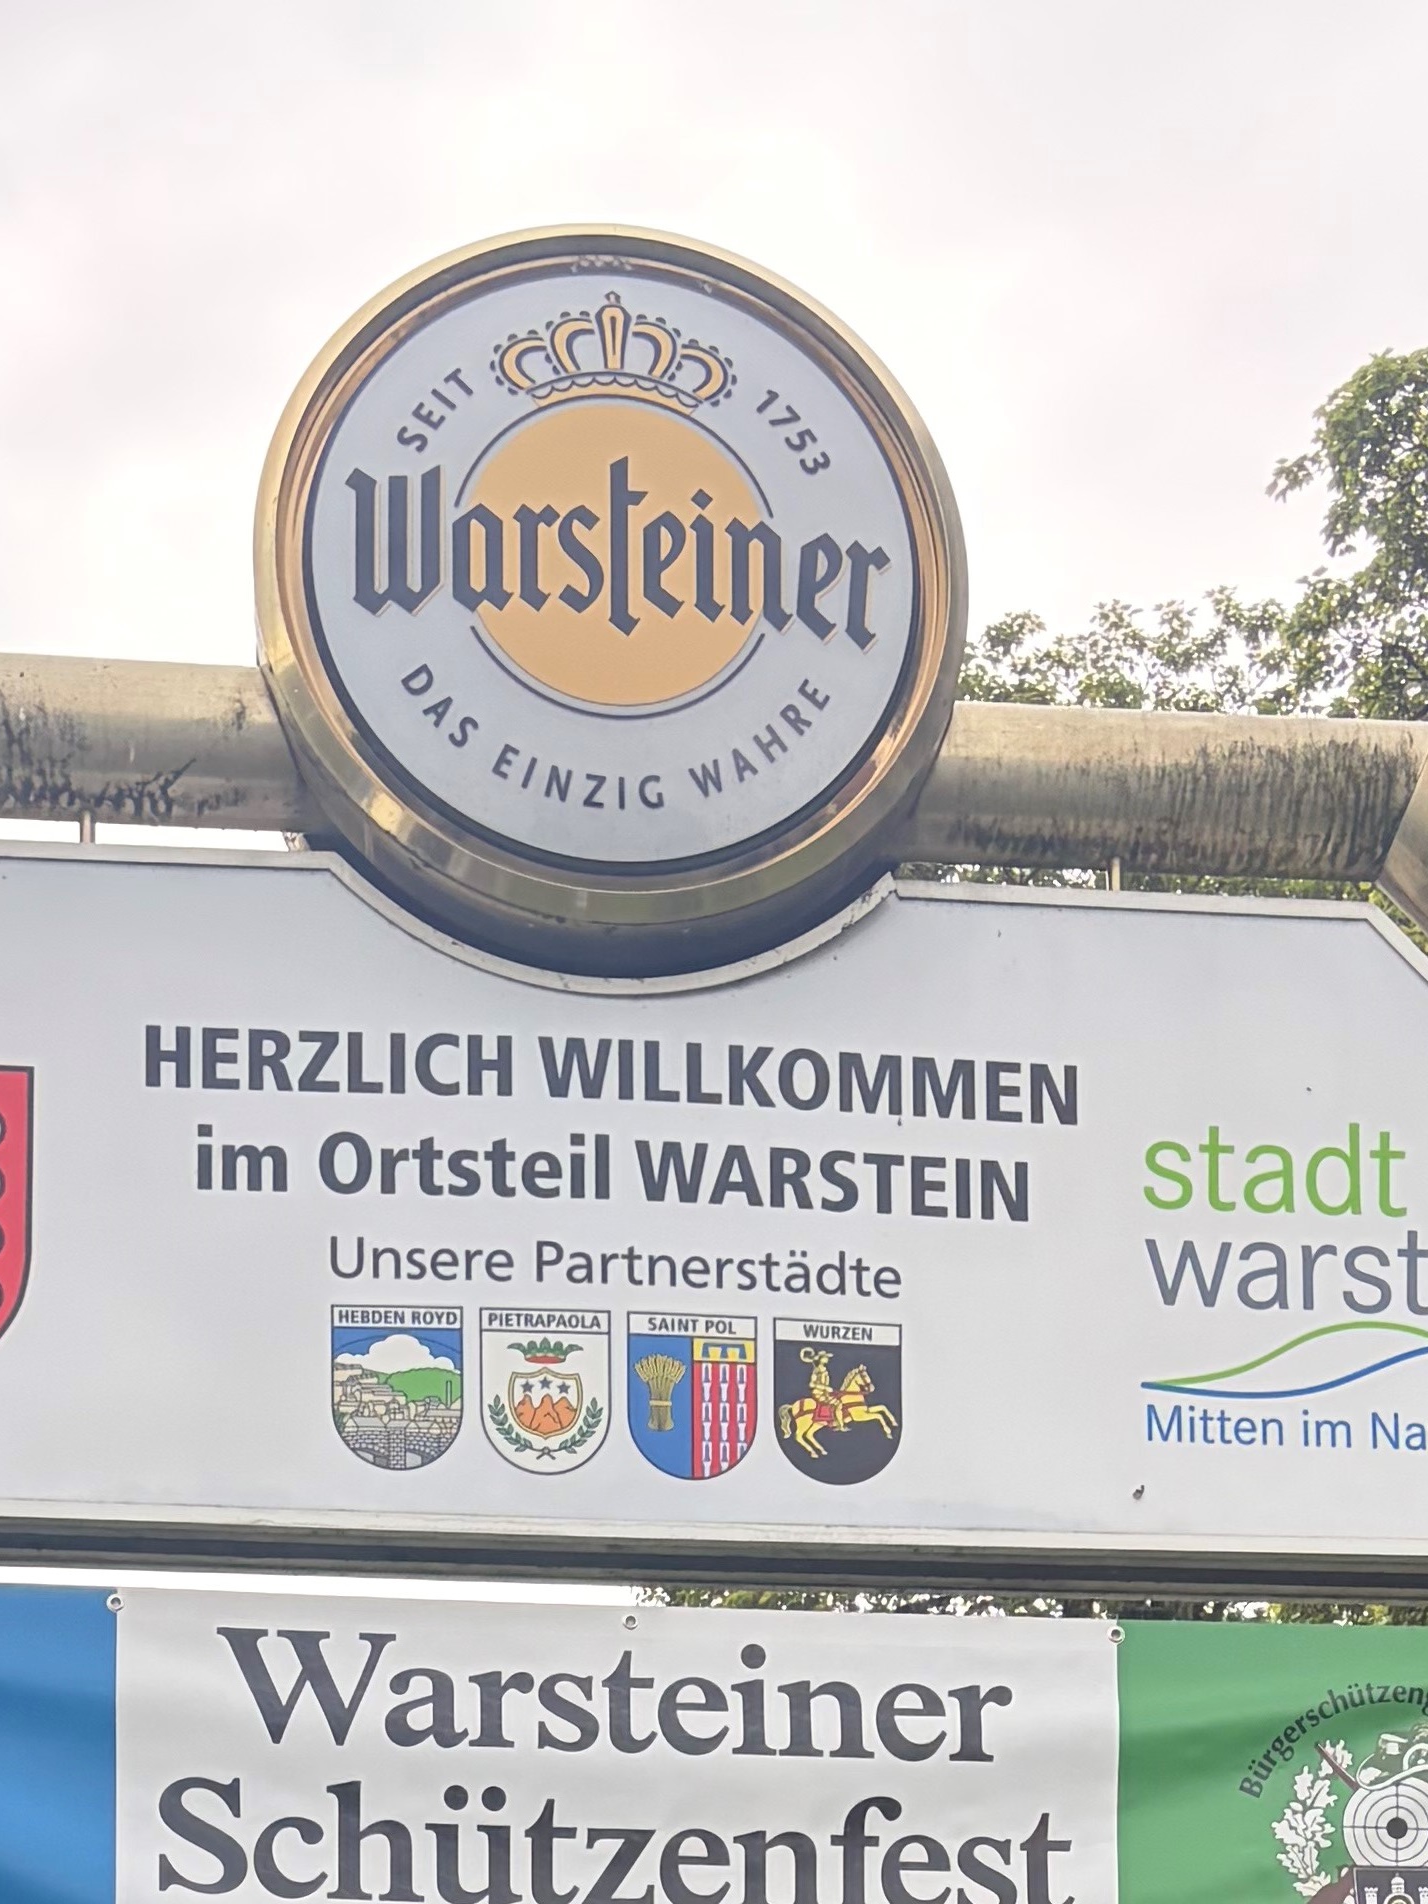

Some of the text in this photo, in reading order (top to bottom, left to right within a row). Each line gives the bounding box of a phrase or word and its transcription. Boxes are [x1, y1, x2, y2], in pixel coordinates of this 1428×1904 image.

[396, 366, 832, 476] SEIT 1753
[344, 455, 892, 653] Warsteiner
[400, 663, 832, 811] DAS EINZIG WAHRE
[145, 1024, 1078, 1126] HERZLICH WILLKOMMEN
[197, 1123, 1029, 1223] im Ortsteil WARSTEIN
[1143, 1122, 1408, 1219] stadt
[330, 1235, 902, 1299] Unsere Partnerstädte
[338, 1309, 458, 1327] HEBDEN ROYD
[488, 1312, 602, 1331] PIETRAPAOLA
[647, 1316, 738, 1336] SAINT POL
[802, 1323, 874, 1341] WURZEN
[1146, 1404, 1284, 1447] Mitten
[1301, 1409, 1352, 1448] im
[217, 1626, 1013, 1763] Warsteiner
